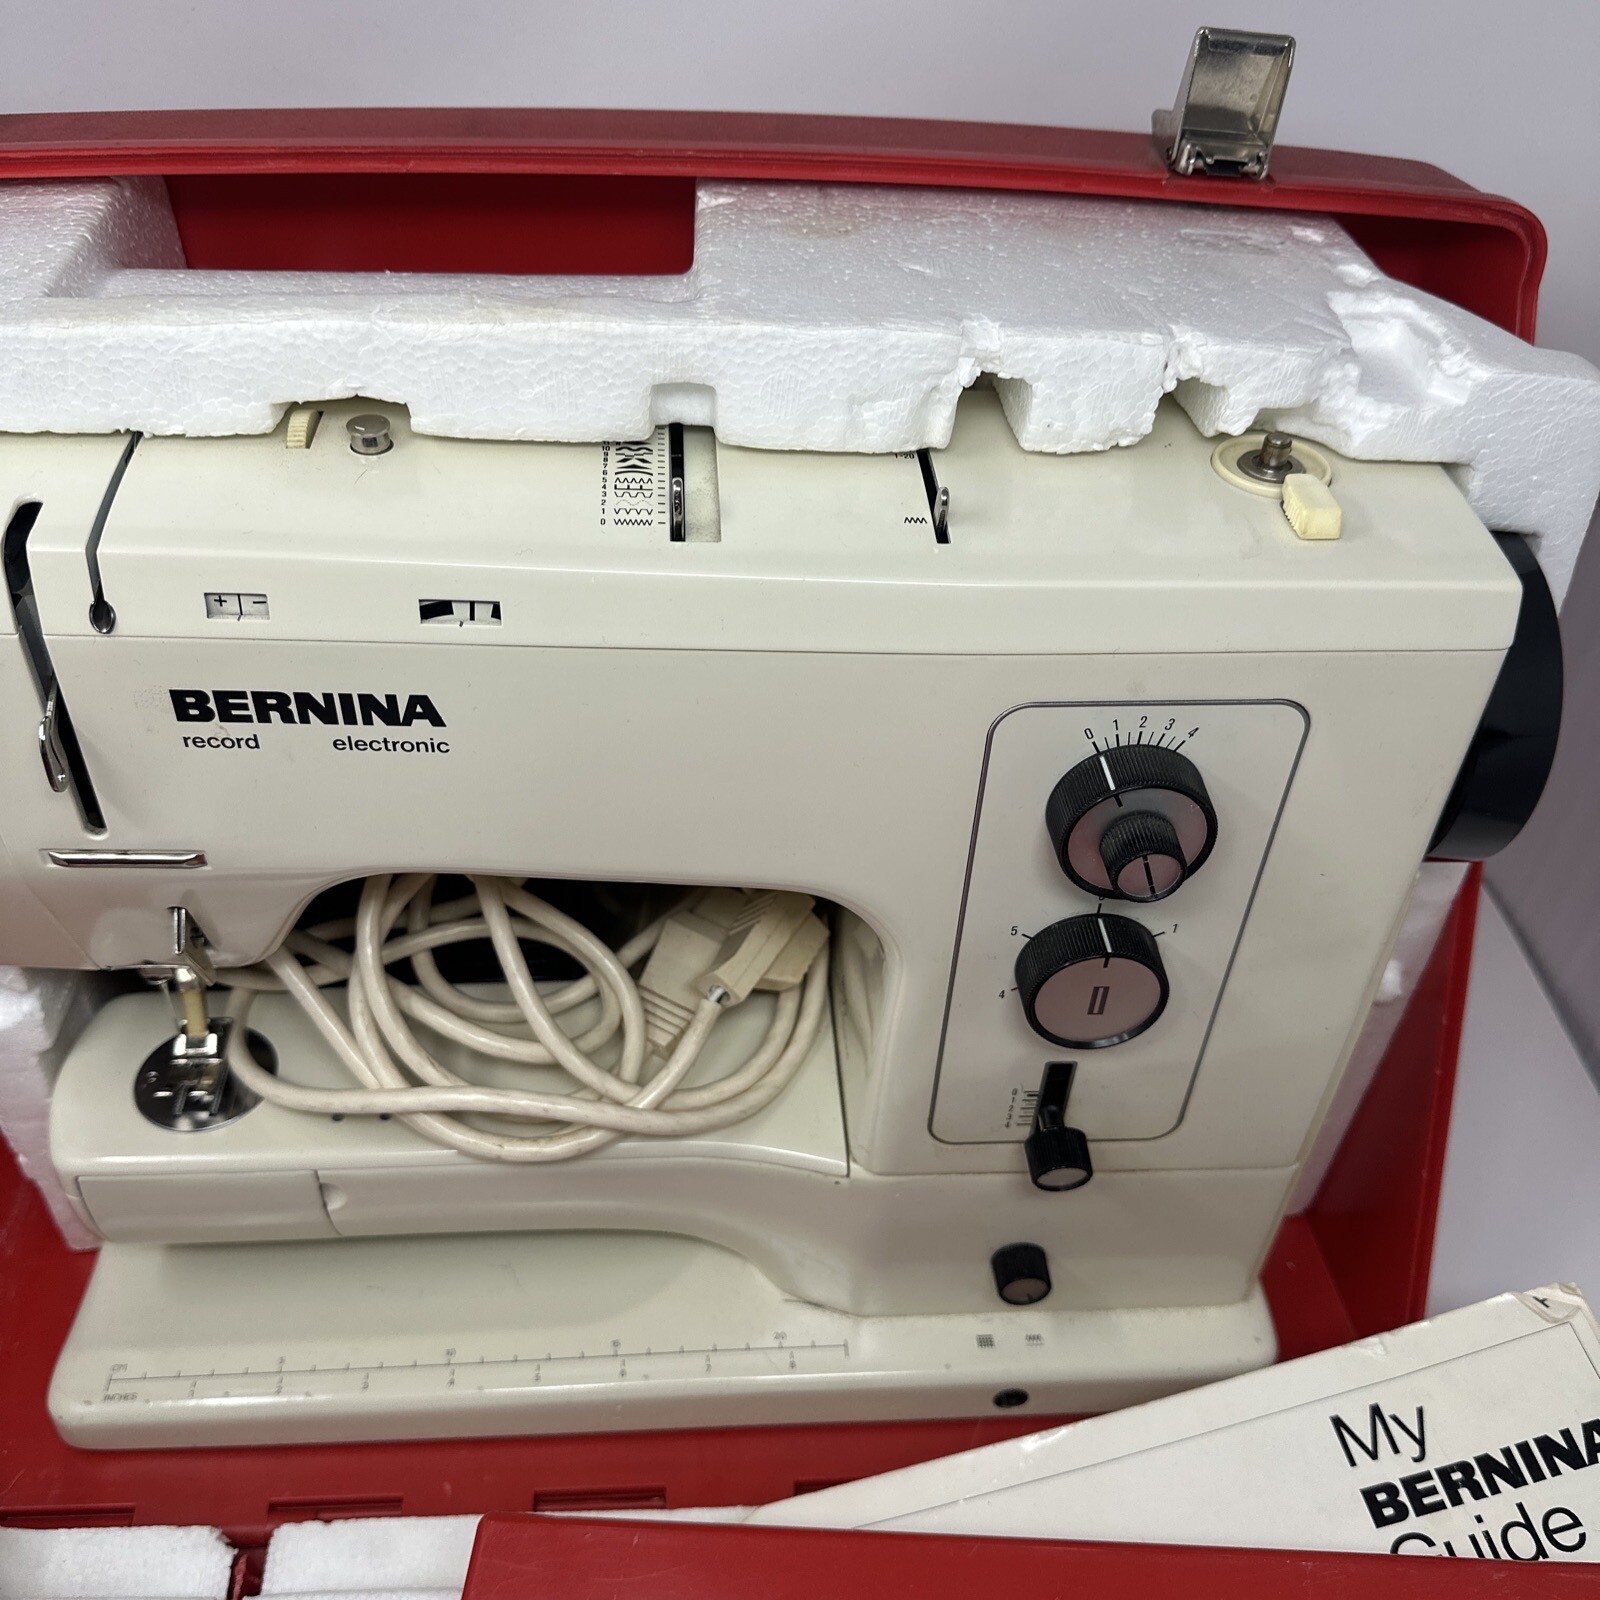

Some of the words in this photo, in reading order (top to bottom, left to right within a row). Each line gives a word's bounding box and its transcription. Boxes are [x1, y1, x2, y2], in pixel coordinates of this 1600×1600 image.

[600, 518, 606, 526] 0
[168, 689, 447, 727] BERNINA
[1084, 727, 1094, 740] 0
[1112, 719, 1119, 731] 1
[1139, 715, 1148, 728] 2
[1164, 718, 1176, 731] 3
[1187, 726, 1200, 739] 4
[182, 734, 260, 749] record
[332, 736, 450, 753] electronic
[1010, 925, 1019, 936] 5
[1171, 923, 1179, 934] 1
[998, 989, 1006, 999] 4
[1329, 1402, 1426, 1468] My
